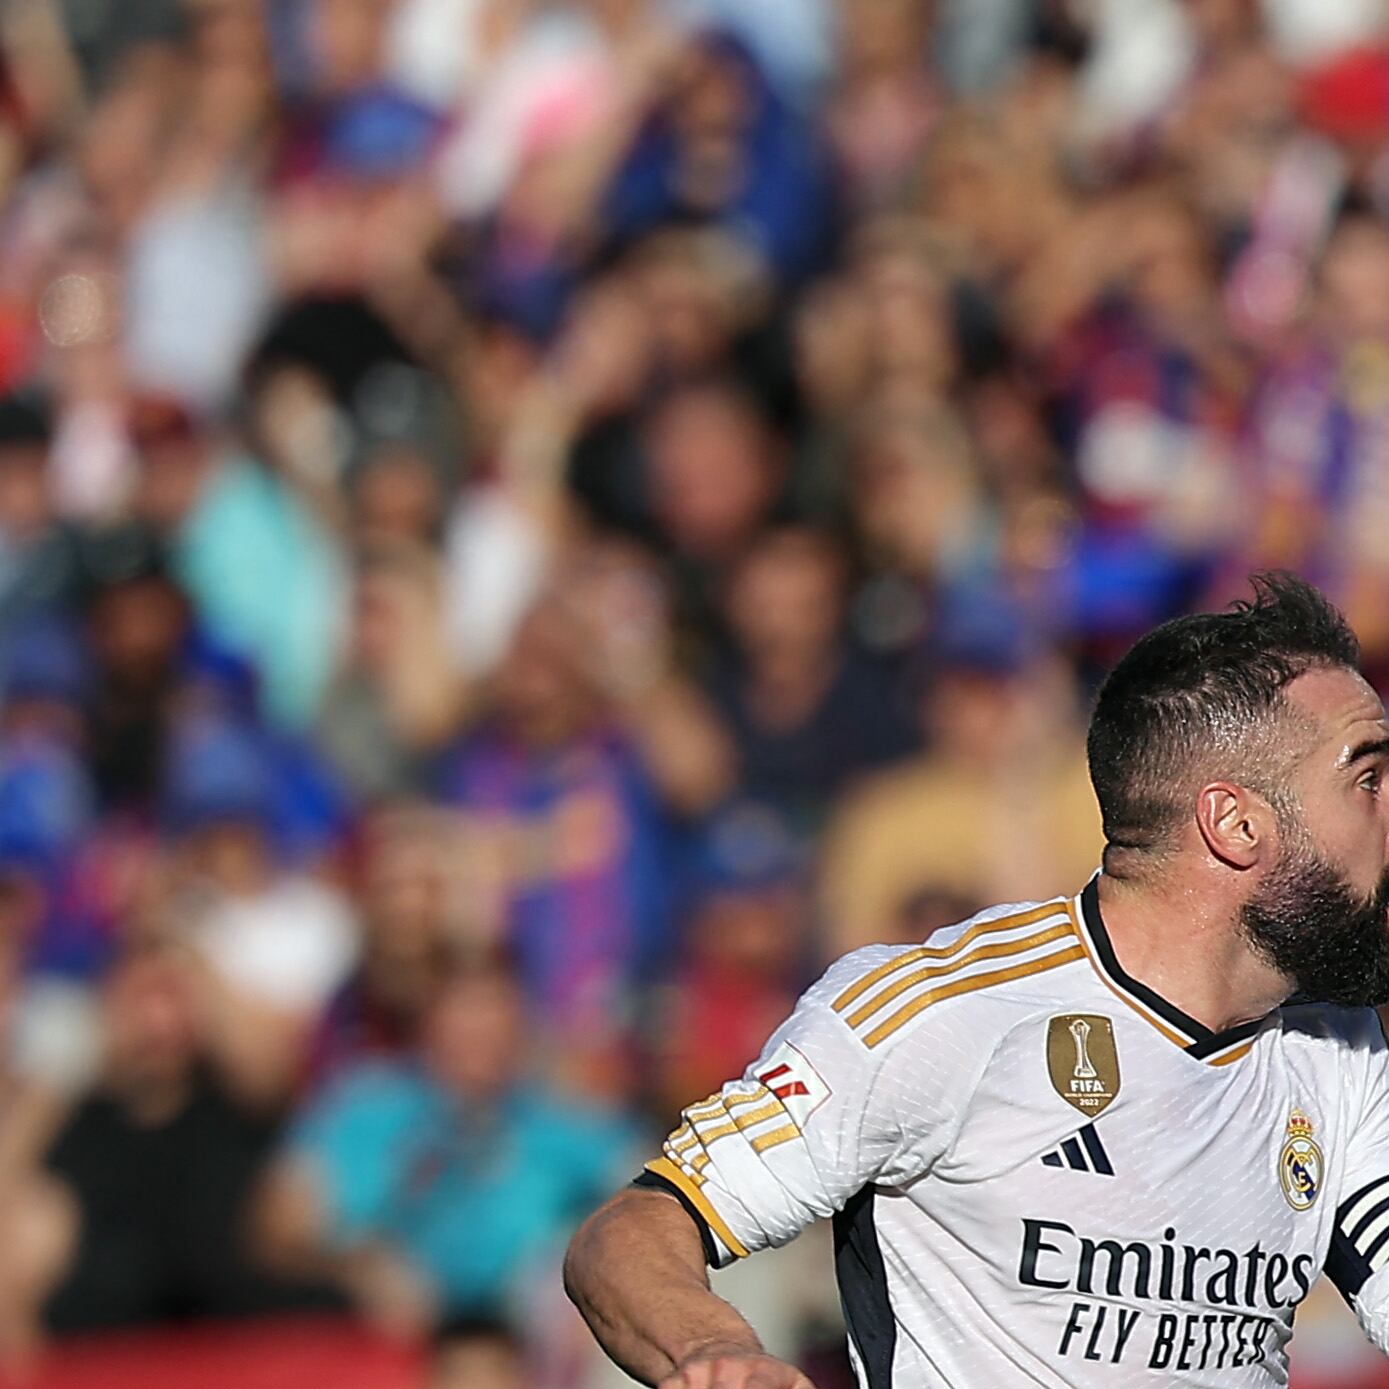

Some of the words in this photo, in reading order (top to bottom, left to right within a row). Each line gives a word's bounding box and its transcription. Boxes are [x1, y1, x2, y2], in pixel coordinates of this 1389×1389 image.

[1070, 1080, 1104, 1092] FIFA
[1018, 1218, 1313, 1309] Emirates
[1058, 1303, 1141, 1363] FLY
[1148, 1313, 1275, 1370] BETTER
